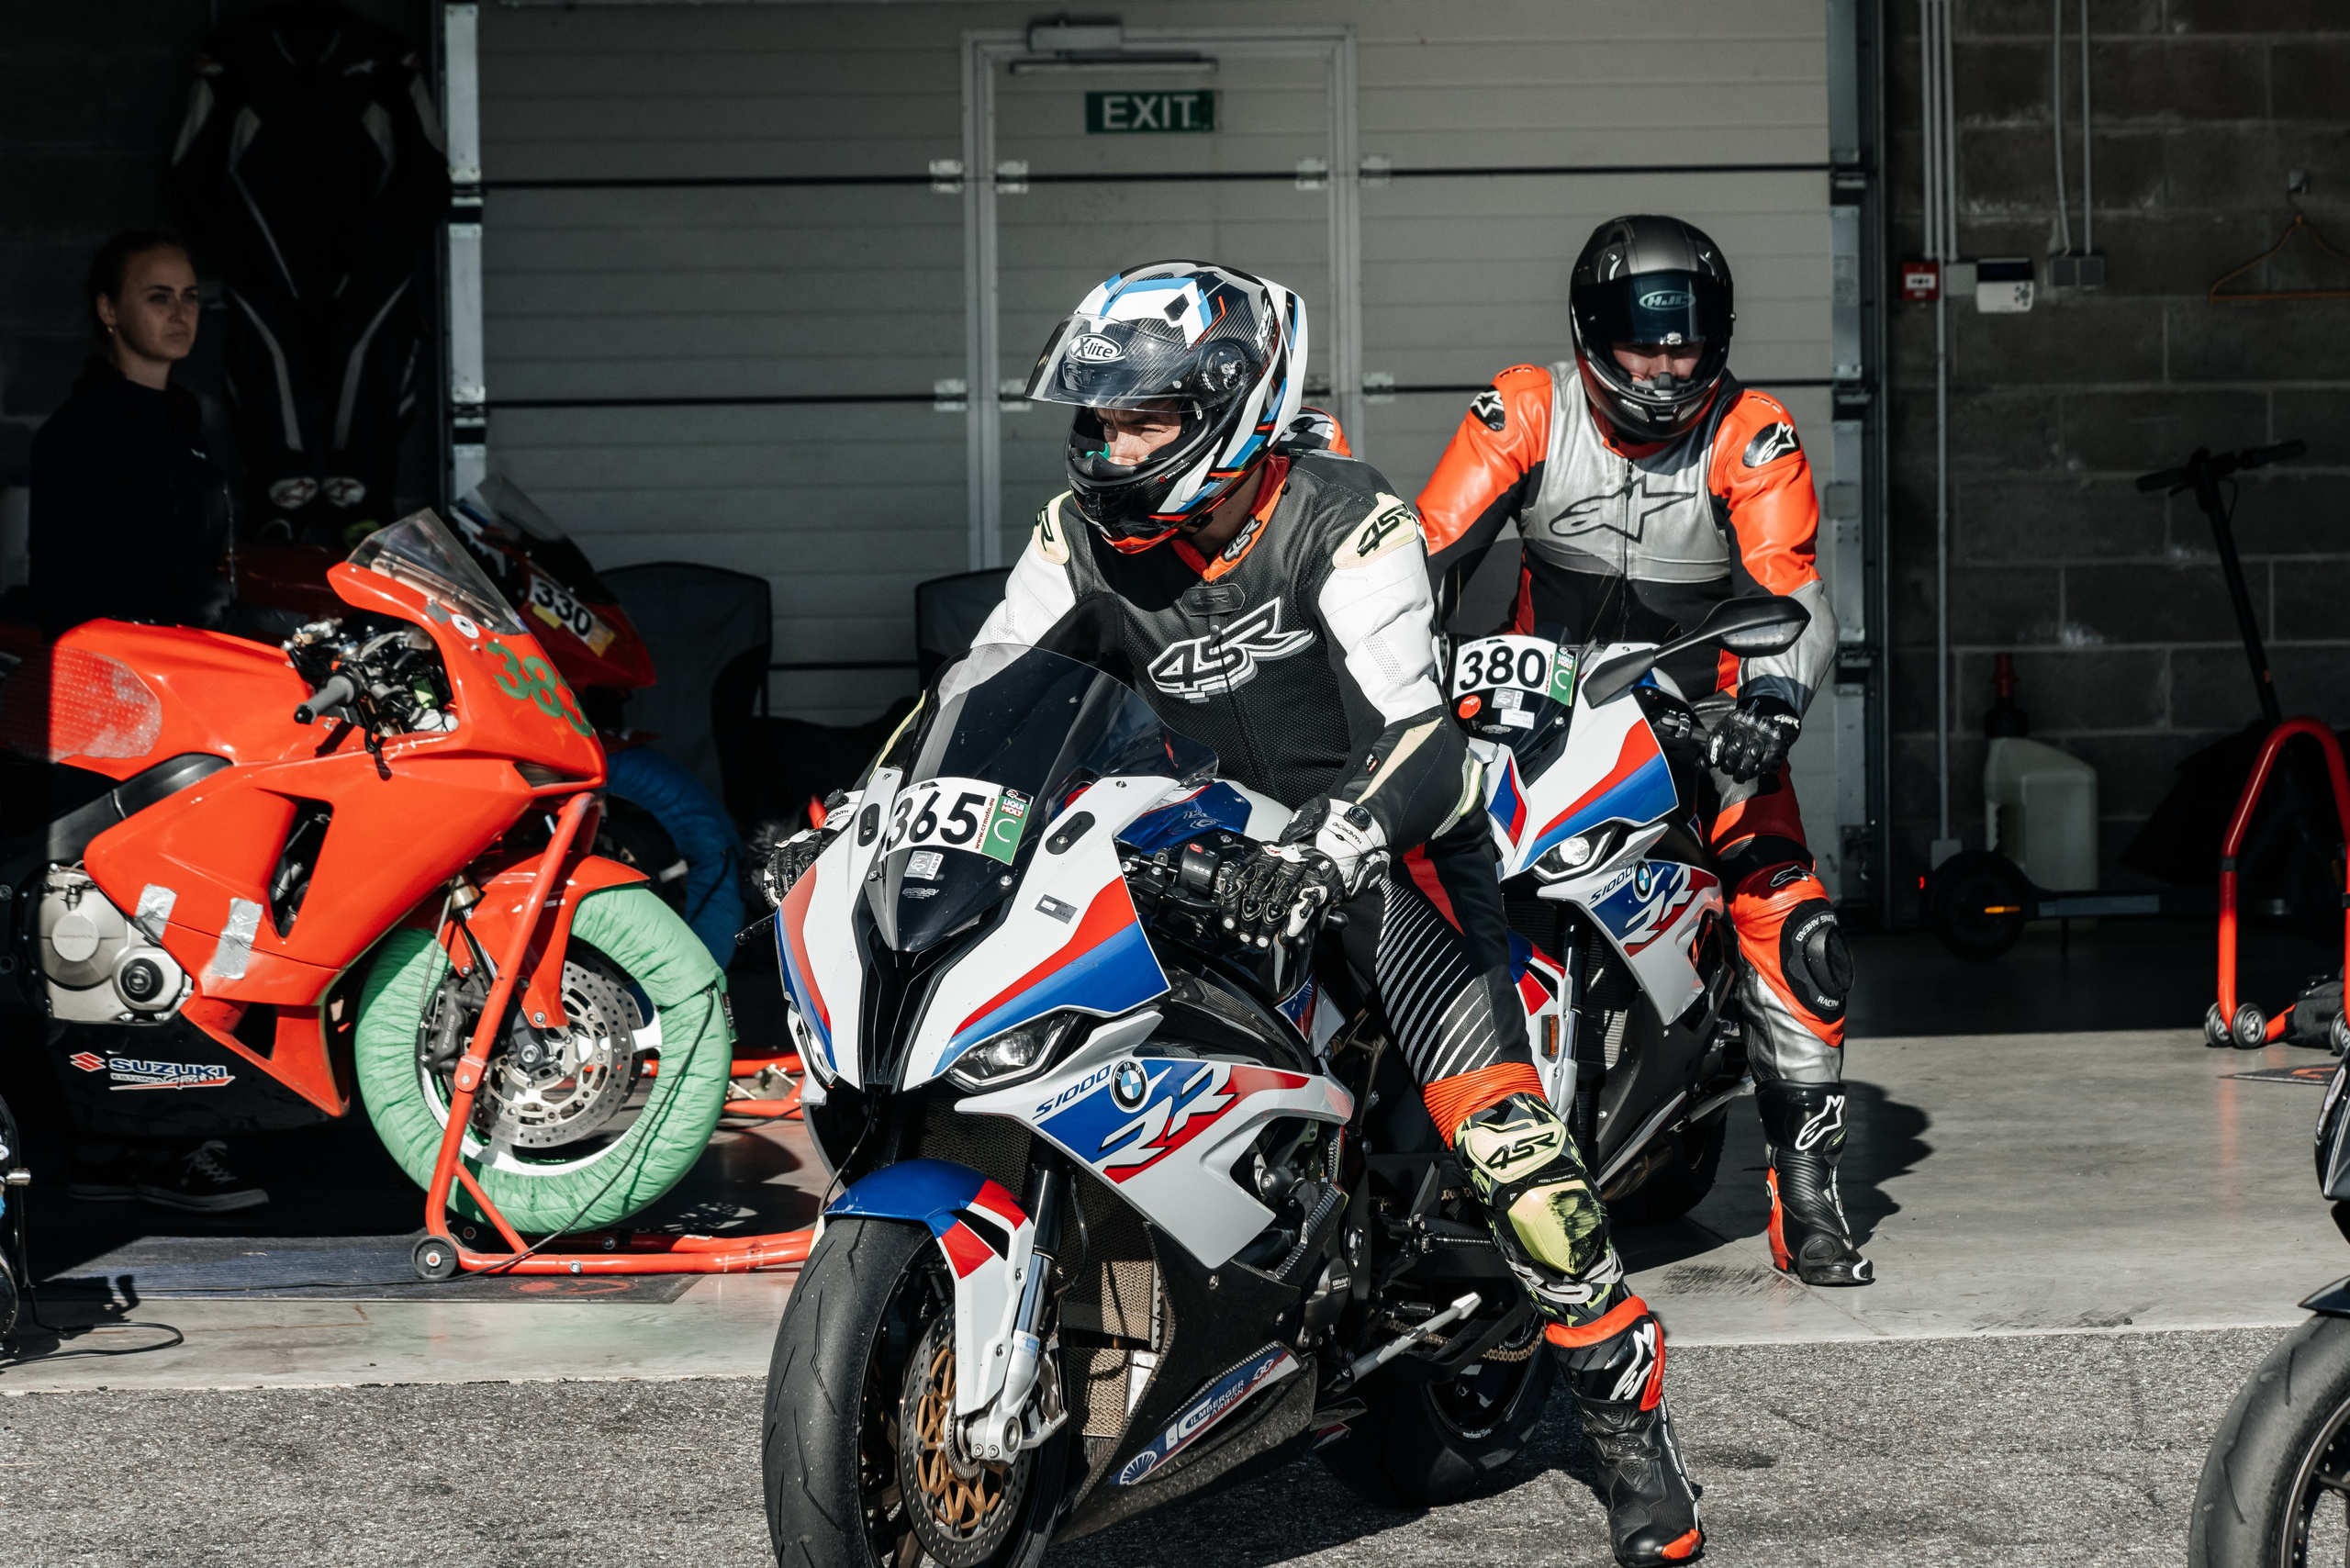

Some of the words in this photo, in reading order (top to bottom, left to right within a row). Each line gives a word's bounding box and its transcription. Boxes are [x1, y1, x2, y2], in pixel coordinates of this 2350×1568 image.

[1103, 95, 1199, 129] EXIT
[1647, 295, 1689, 307] HJC
[1225, 519, 1260, 560] 4SR
[535, 582, 591, 635] 330
[1147, 597, 1316, 703] 4SR
[1460, 645, 1547, 690] 380
[1554, 669, 1570, 690] C
[886, 790, 987, 851] 365
[1001, 804, 1024, 818] MOLY
[1002, 798, 1026, 812] LIQUI
[975, 797, 996, 850] www.crmoto.eu
[993, 818, 1017, 844] C
[1588, 864, 1634, 905] S1000
[1796, 918, 1819, 942] AHEAD
[109, 1058, 228, 1078] SUZUKI
[110, 1073, 164, 1083] ESTONIA
[1115, 1062, 1144, 1081] BMW
[1032, 1064, 1112, 1121] S1000
[1485, 1132, 1558, 1170] 4SR
[1191, 1380, 1244, 1425] ILMBERGER
